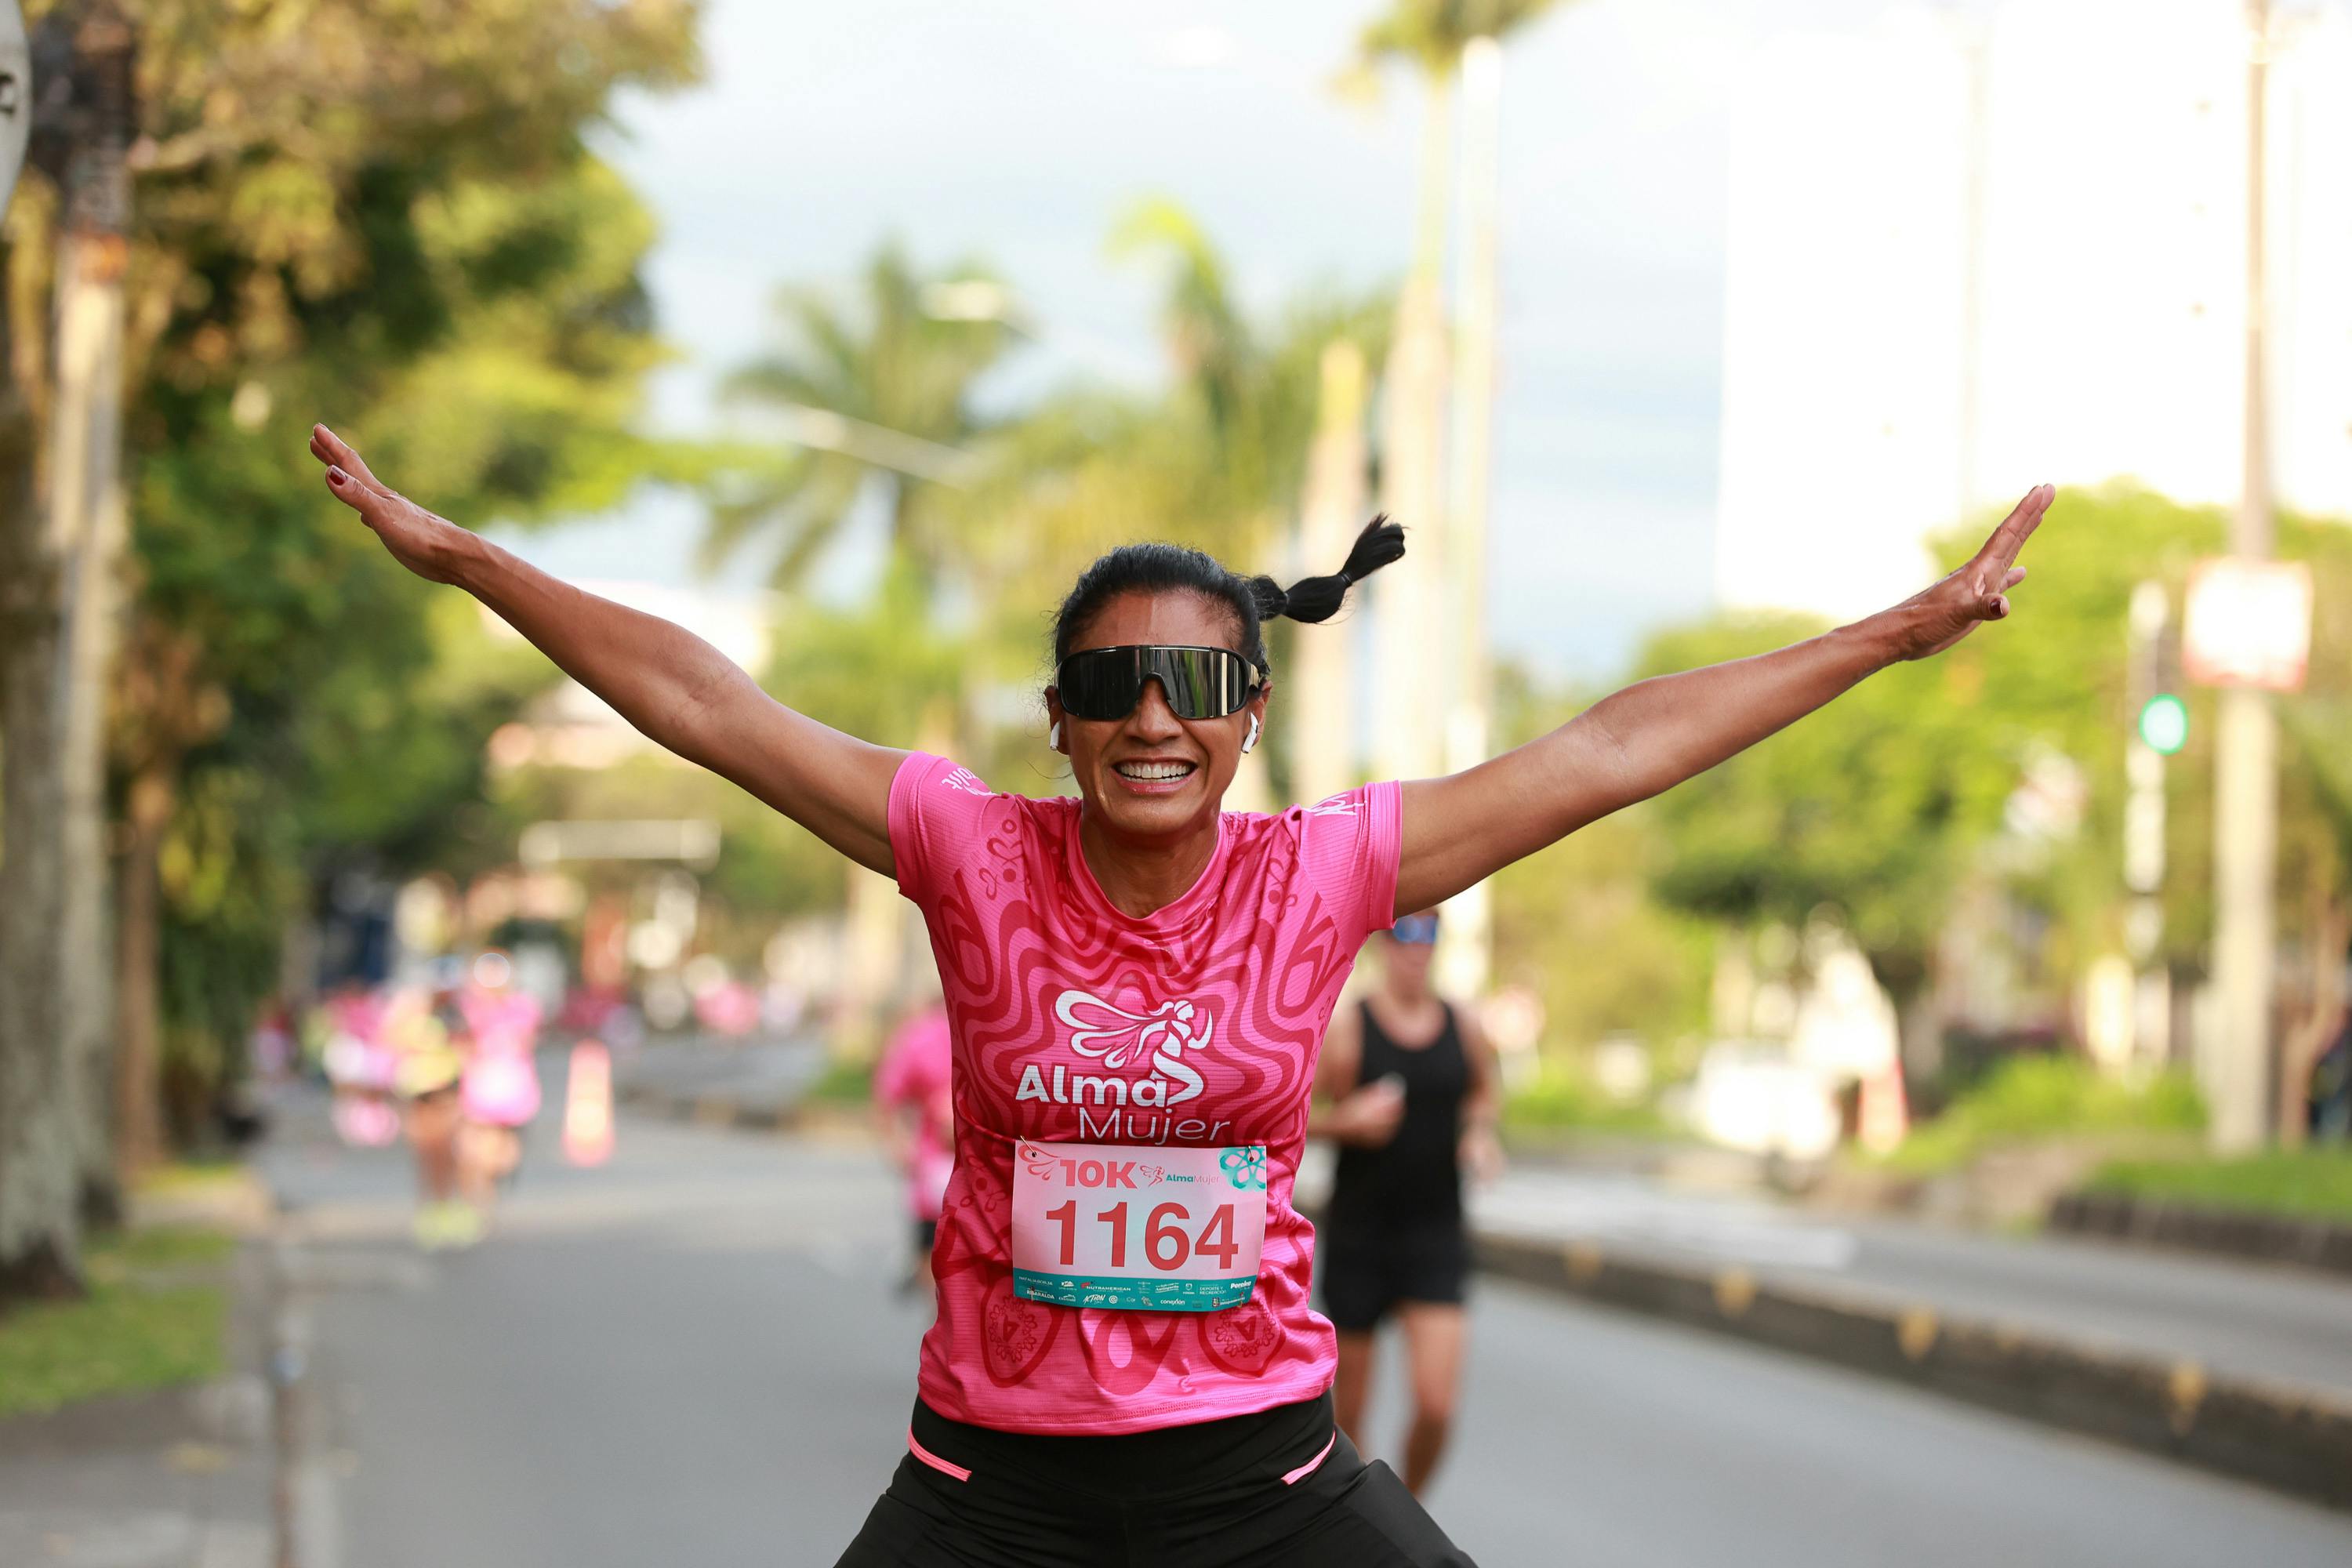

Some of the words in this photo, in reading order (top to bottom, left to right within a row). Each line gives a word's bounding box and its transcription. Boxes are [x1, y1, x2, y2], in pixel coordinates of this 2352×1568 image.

[1015, 1065, 1167, 1108] Alma
[1079, 1106, 1231, 1146] Mujer
[1059, 1159, 1138, 1189] 10K
[1046, 1200, 1239, 1271] 1164
